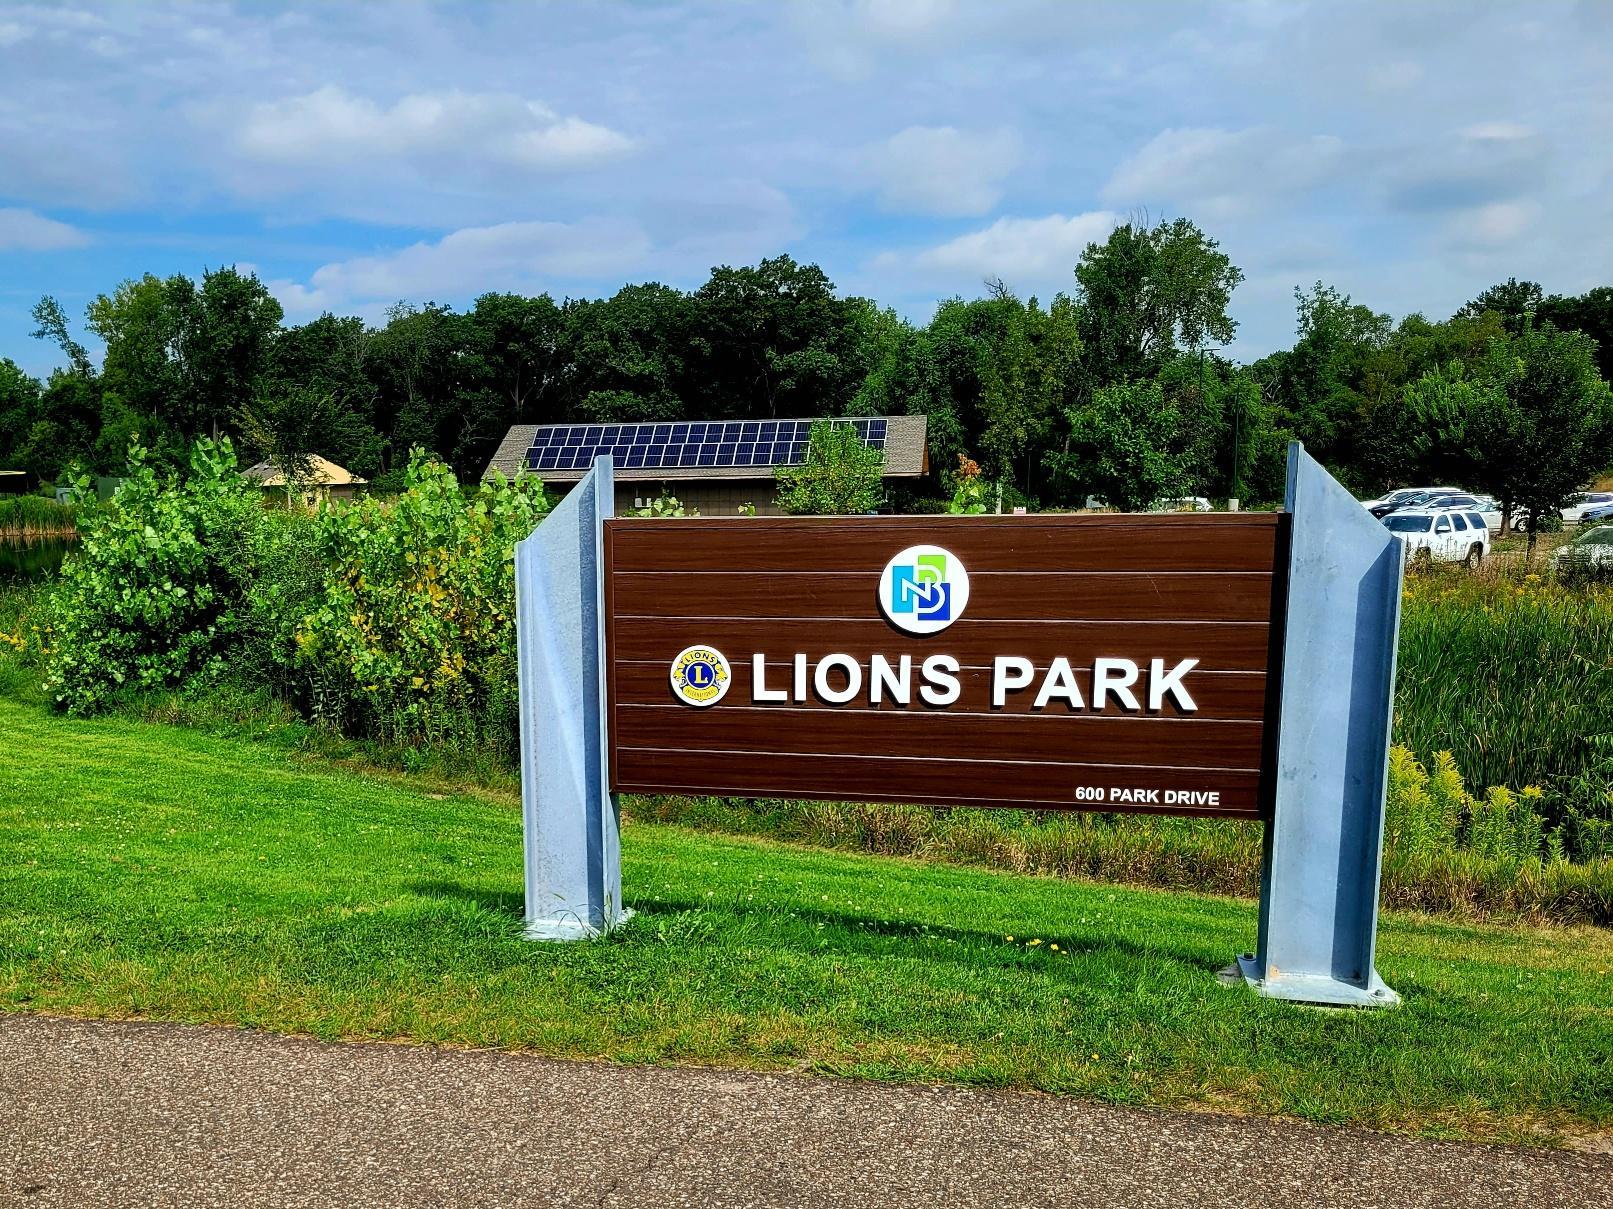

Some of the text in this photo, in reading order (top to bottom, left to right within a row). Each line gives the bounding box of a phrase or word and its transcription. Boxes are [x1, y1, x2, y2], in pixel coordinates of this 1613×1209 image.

[685, 651, 715, 663] LIONS
[694, 666, 709, 683] L
[752, 653, 1200, 711] LIONS PARK
[1075, 787, 1220, 806] 600 PARK DRIVE
